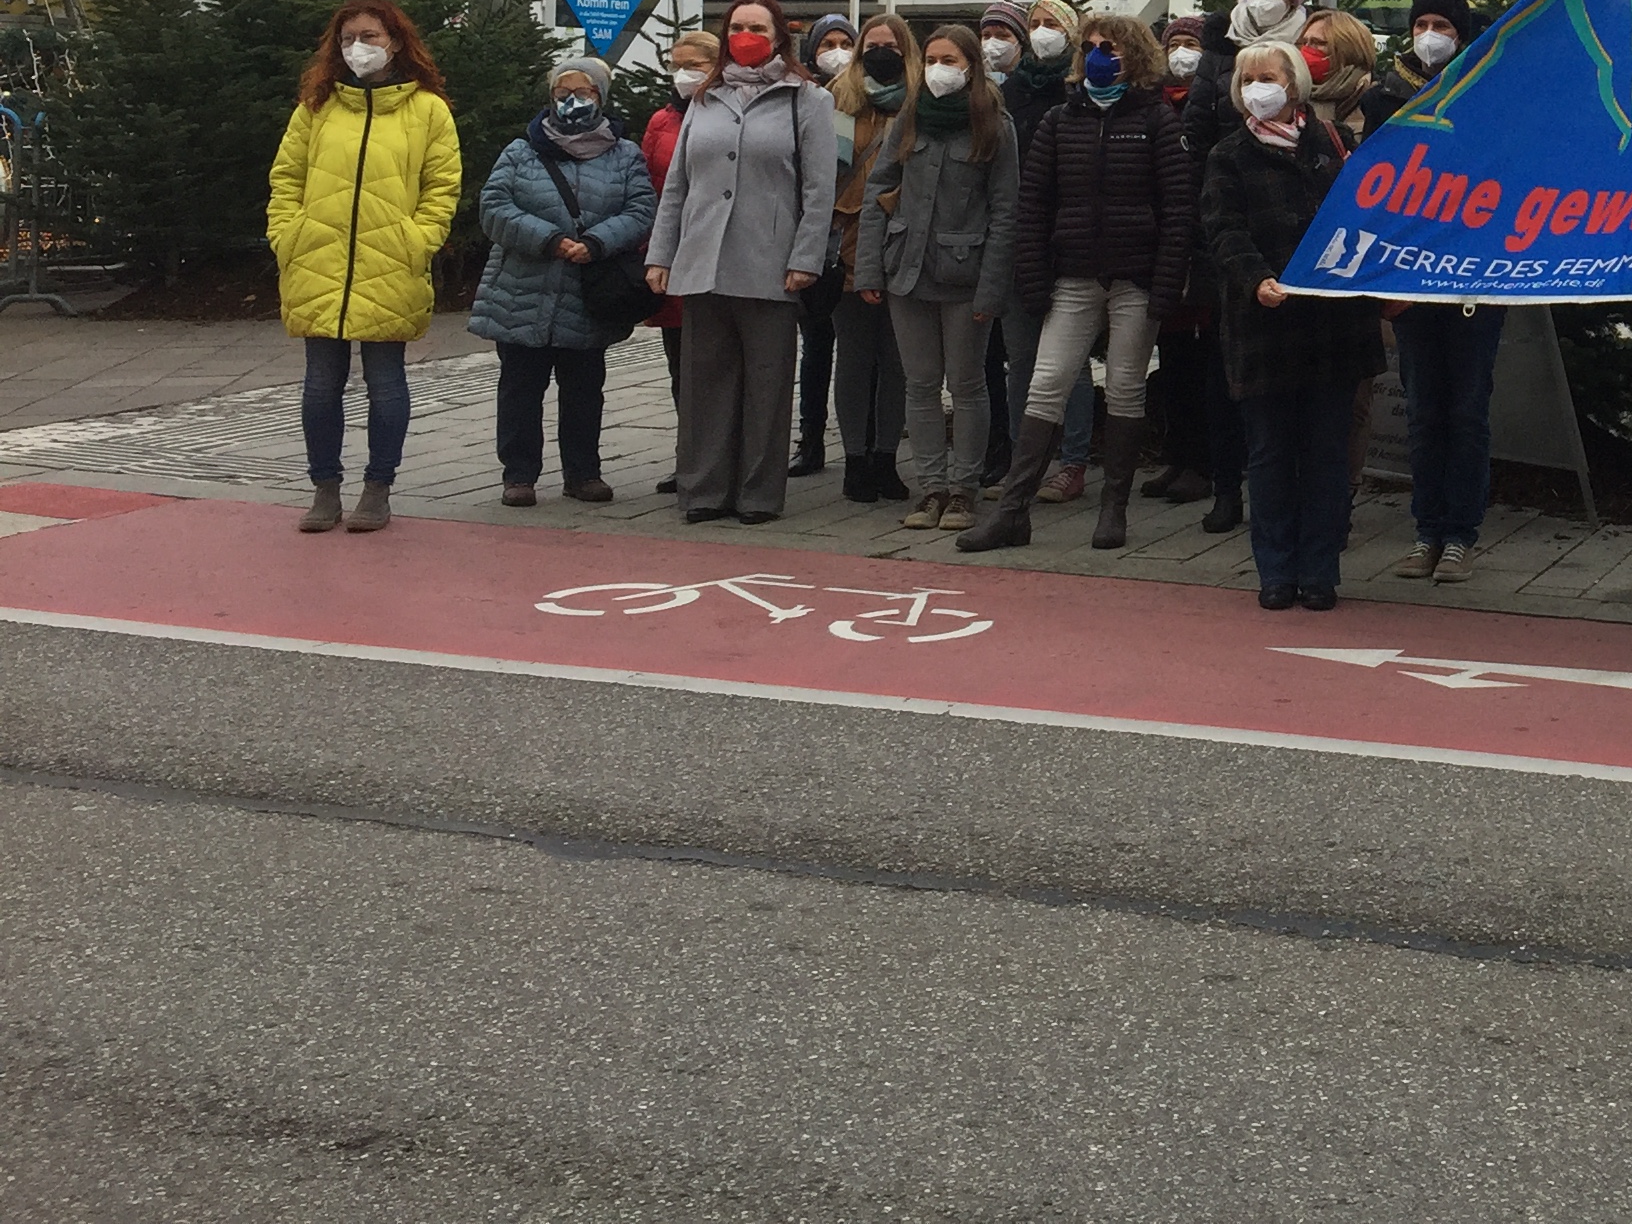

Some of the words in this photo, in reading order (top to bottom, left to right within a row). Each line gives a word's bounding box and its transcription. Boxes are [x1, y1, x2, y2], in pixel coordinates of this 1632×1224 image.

[592, 27, 613, 40] SAM
[1355, 143, 1502, 229] ohne
[1379, 240, 1481, 277] TERRE
[1485, 258, 1549, 278] DES
